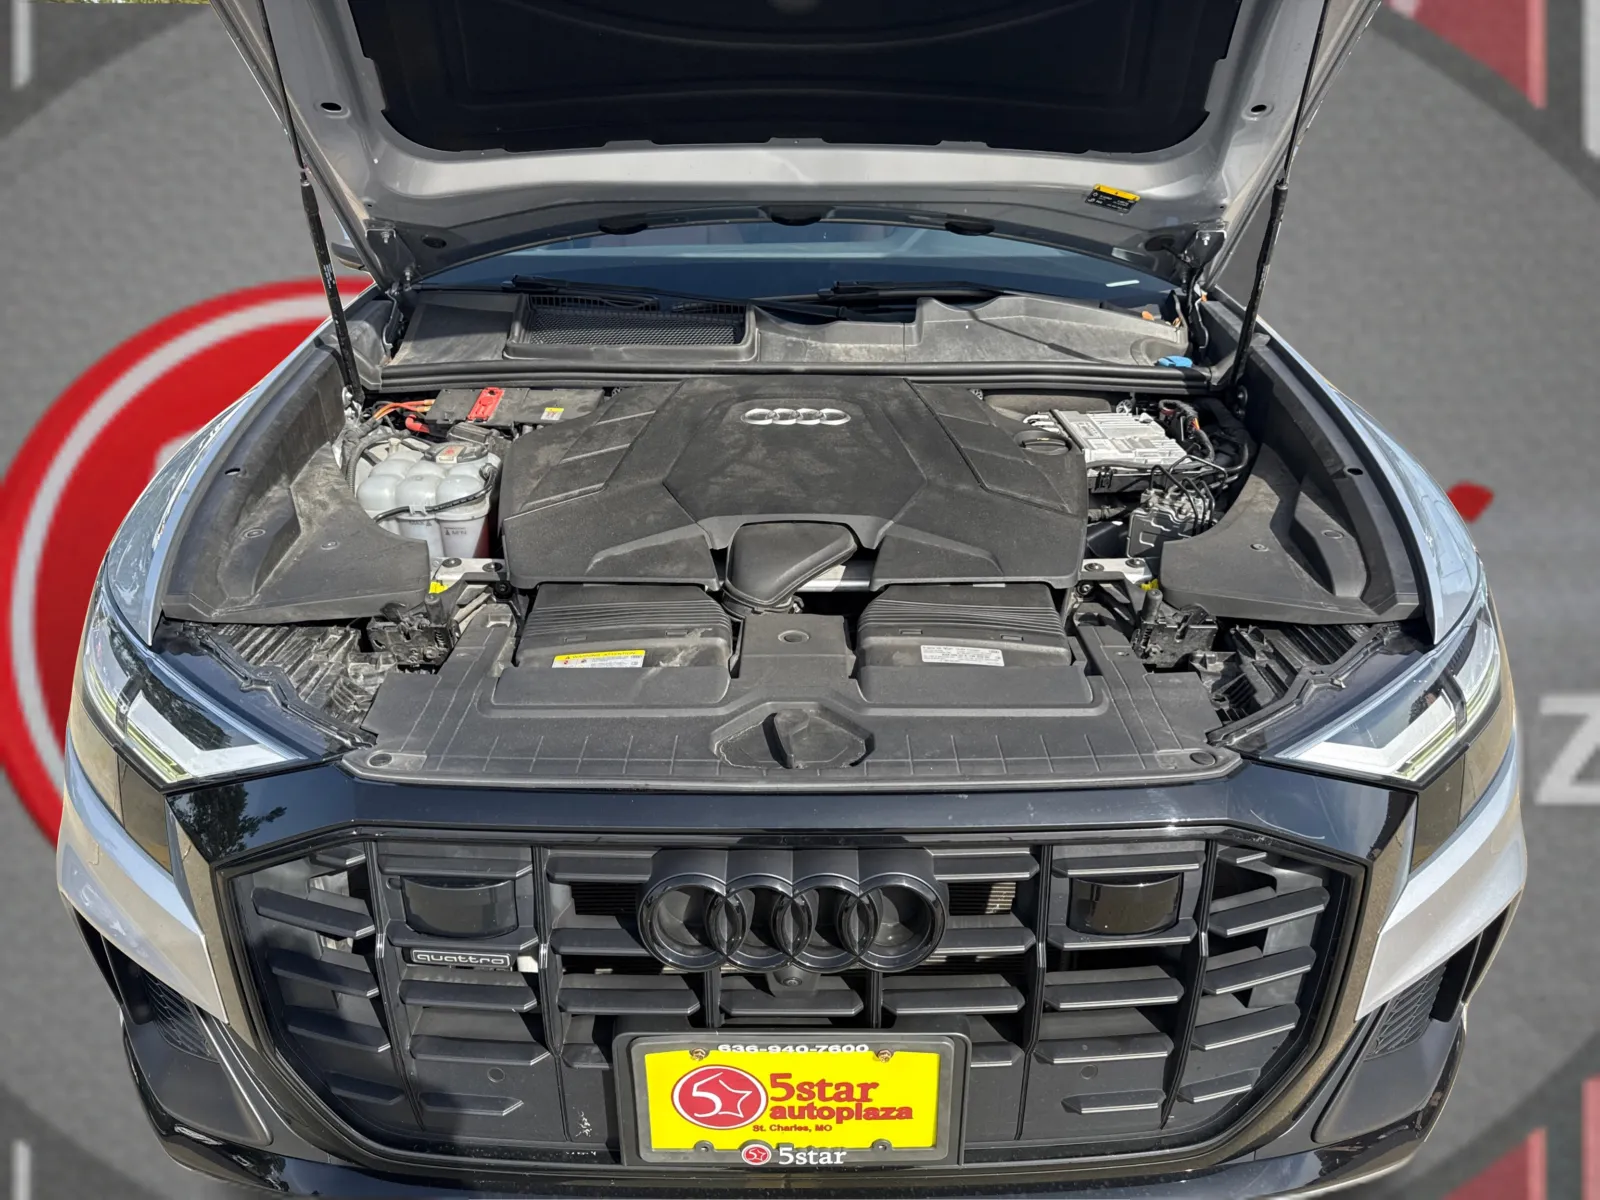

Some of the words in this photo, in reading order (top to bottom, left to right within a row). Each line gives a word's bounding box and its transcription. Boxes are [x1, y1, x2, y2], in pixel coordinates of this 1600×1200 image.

[416, 953, 505, 965] quattro
[717, 1044, 870, 1054] 636-940-7600
[769, 1072, 880, 1103] 5star
[769, 1101, 914, 1124] autoplaza
[752, 1124, 767, 1132] St.
[769, 1124, 812, 1133] Charles,
[815, 1124, 833, 1132] MO
[778, 1146, 847, 1166] 5star
